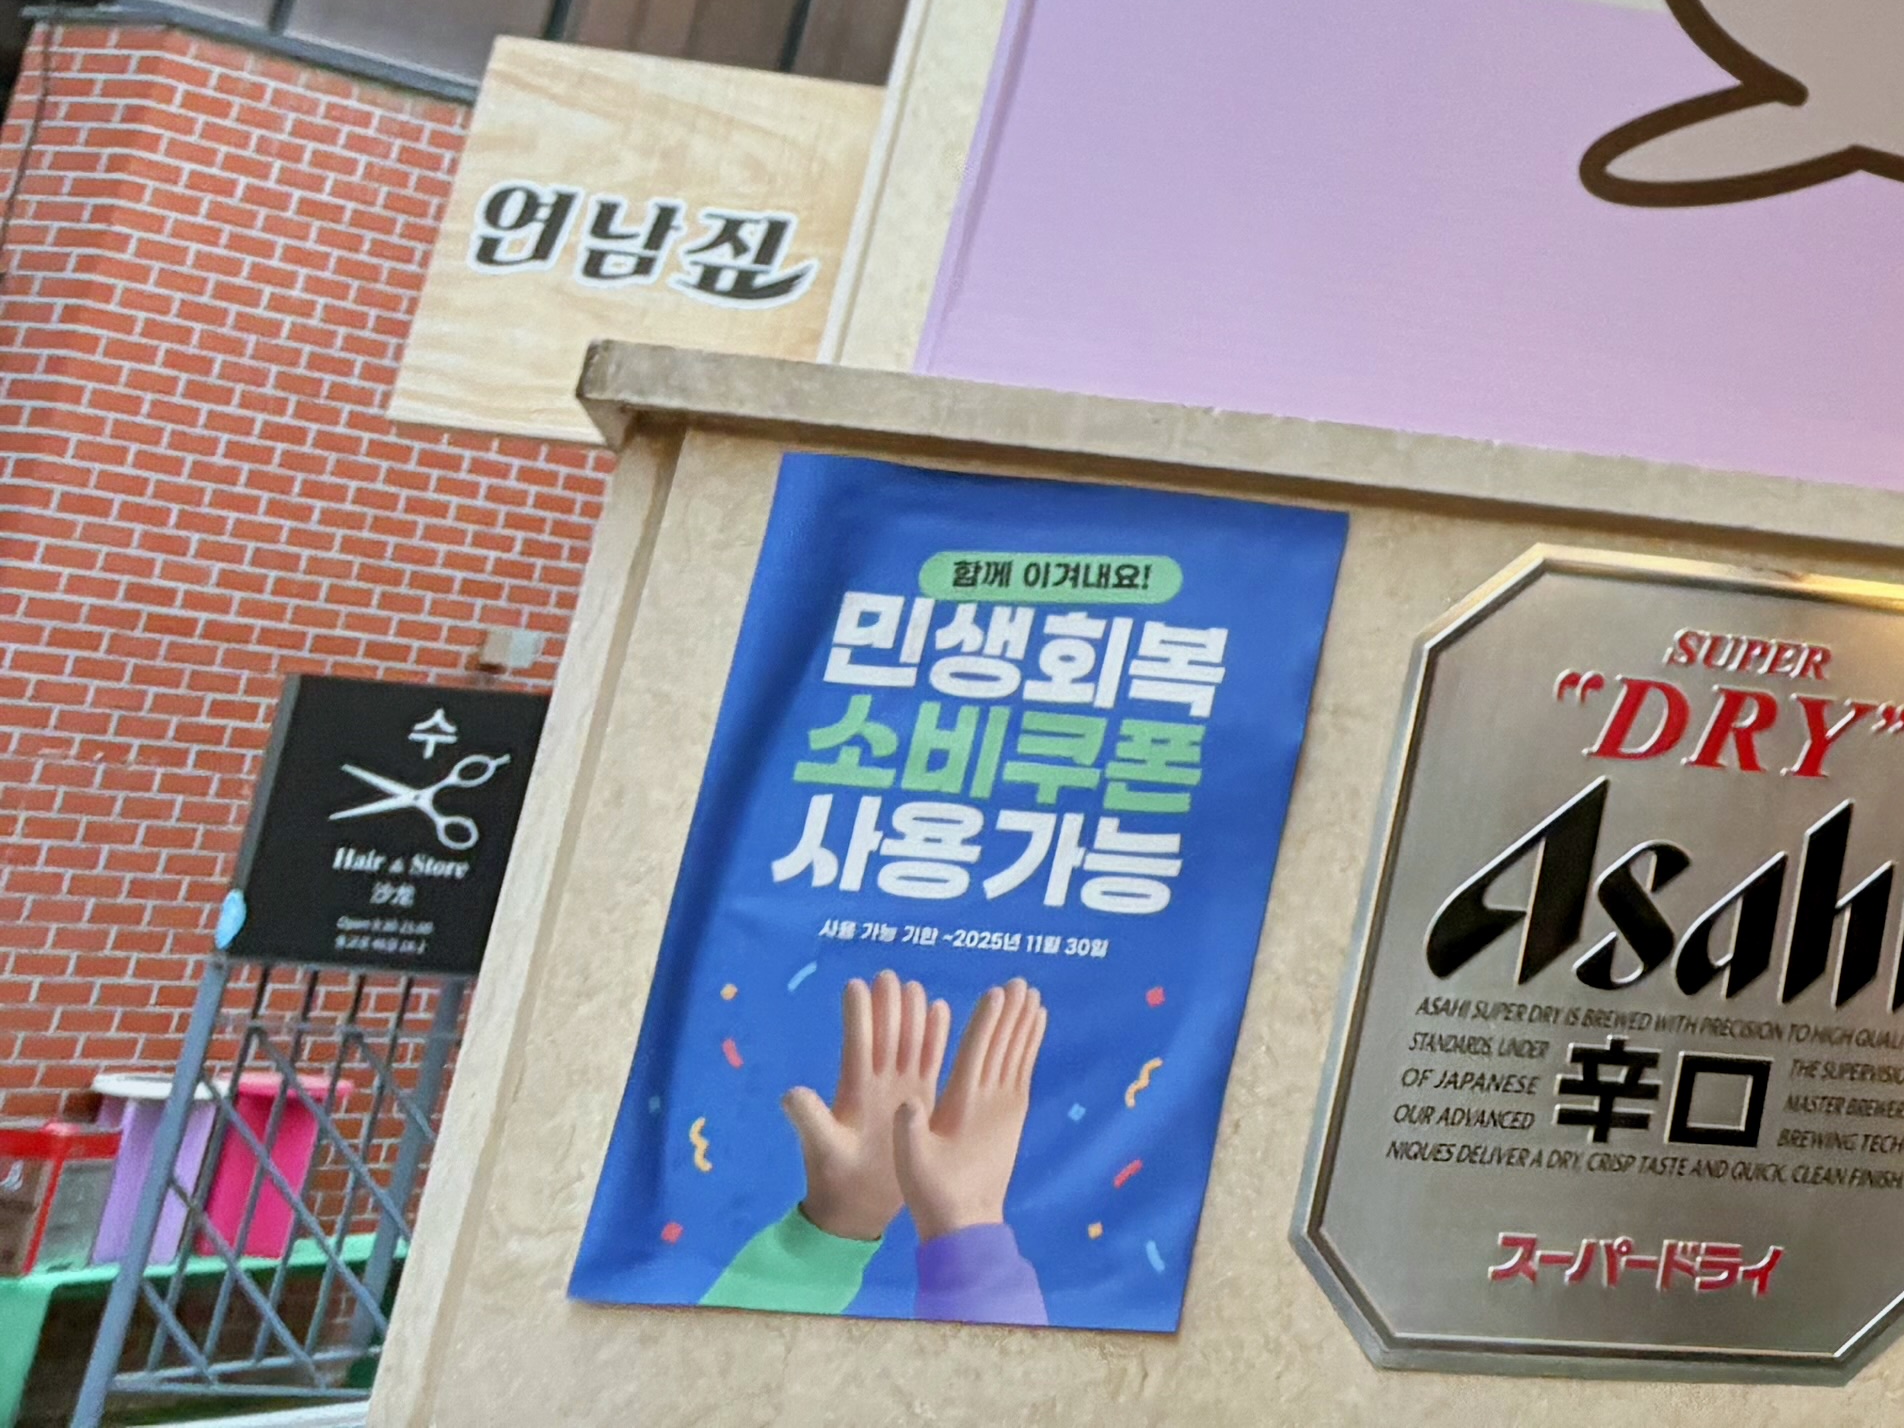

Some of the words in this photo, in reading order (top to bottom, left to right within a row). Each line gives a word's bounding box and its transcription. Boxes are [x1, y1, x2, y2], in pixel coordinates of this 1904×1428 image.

[951, 560, 1015, 589] 함께
[1022, 561, 1153, 590] 이겨내요!
[821, 590, 1230, 717] 민생회복
[1661, 626, 1833, 681] SUPER
[793, 691, 1204, 815] 소비쿠폰
[332, 846, 387, 872] Hair
[408, 852, 471, 880] Store
[1415, 996, 1470, 1018] ASAHI
[1471, 1000, 1529, 1024] SUPER
[1529, 1004, 1562, 1025] DRY
[1564, 1007, 1582, 1027] IS
[1581, 1007, 1653, 1031] BREWED
[1654, 1013, 1698, 1034] WITH
[1699, 1015, 1784, 1041] PRECISION
[1787, 1022, 1811, 1043] TO
[1401, 1067, 1435, 1088] OF
[1434, 1070, 1541, 1095] JAPANESE
[1551, 1033, 1775, 1148] 辛口
[1393, 1103, 1437, 1126] OUR
[1436, 1107, 1536, 1130] ADVANCED
[1777, 1128, 1860, 1152] BREWING
[1385, 1140, 1457, 1163] NIQUES
[1456, 1143, 1531, 1168] DELIVER
[1529, 1148, 1543, 1169] A
[1587, 1151, 1637, 1174] CRISP
[1638, 1155, 1689, 1178] TASTE
[1690, 1157, 1730, 1180] AND
[1790, 1163, 1849, 1187] CLEAN
[1487, 1232, 1785, 1297] スーパードライ
